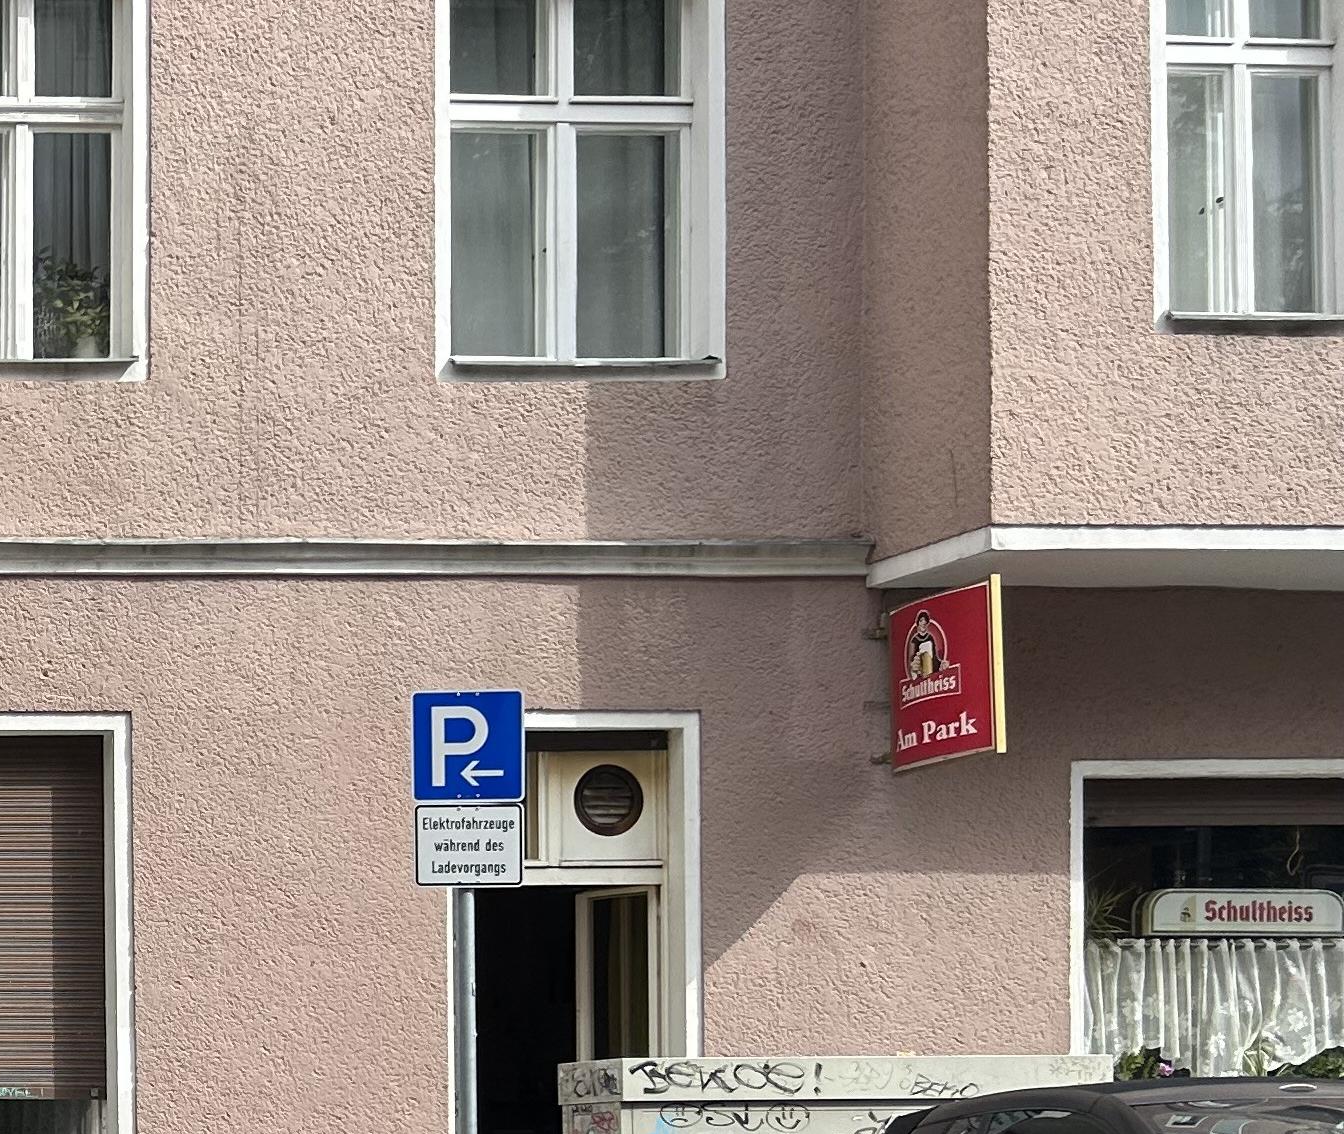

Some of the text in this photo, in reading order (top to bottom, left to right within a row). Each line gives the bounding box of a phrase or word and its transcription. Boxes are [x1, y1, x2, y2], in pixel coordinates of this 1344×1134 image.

[901, 675, 957, 702] Schultheiss
[896, 711, 978, 752] Am Park
[431, 706, 489, 787] P
[422, 817, 515, 833] Elektrofahrzeuge
[433, 838, 505, 852] während des
[431, 861, 507, 877] Ladevorgangs
[1204, 899, 1314, 923] Schultheiss
